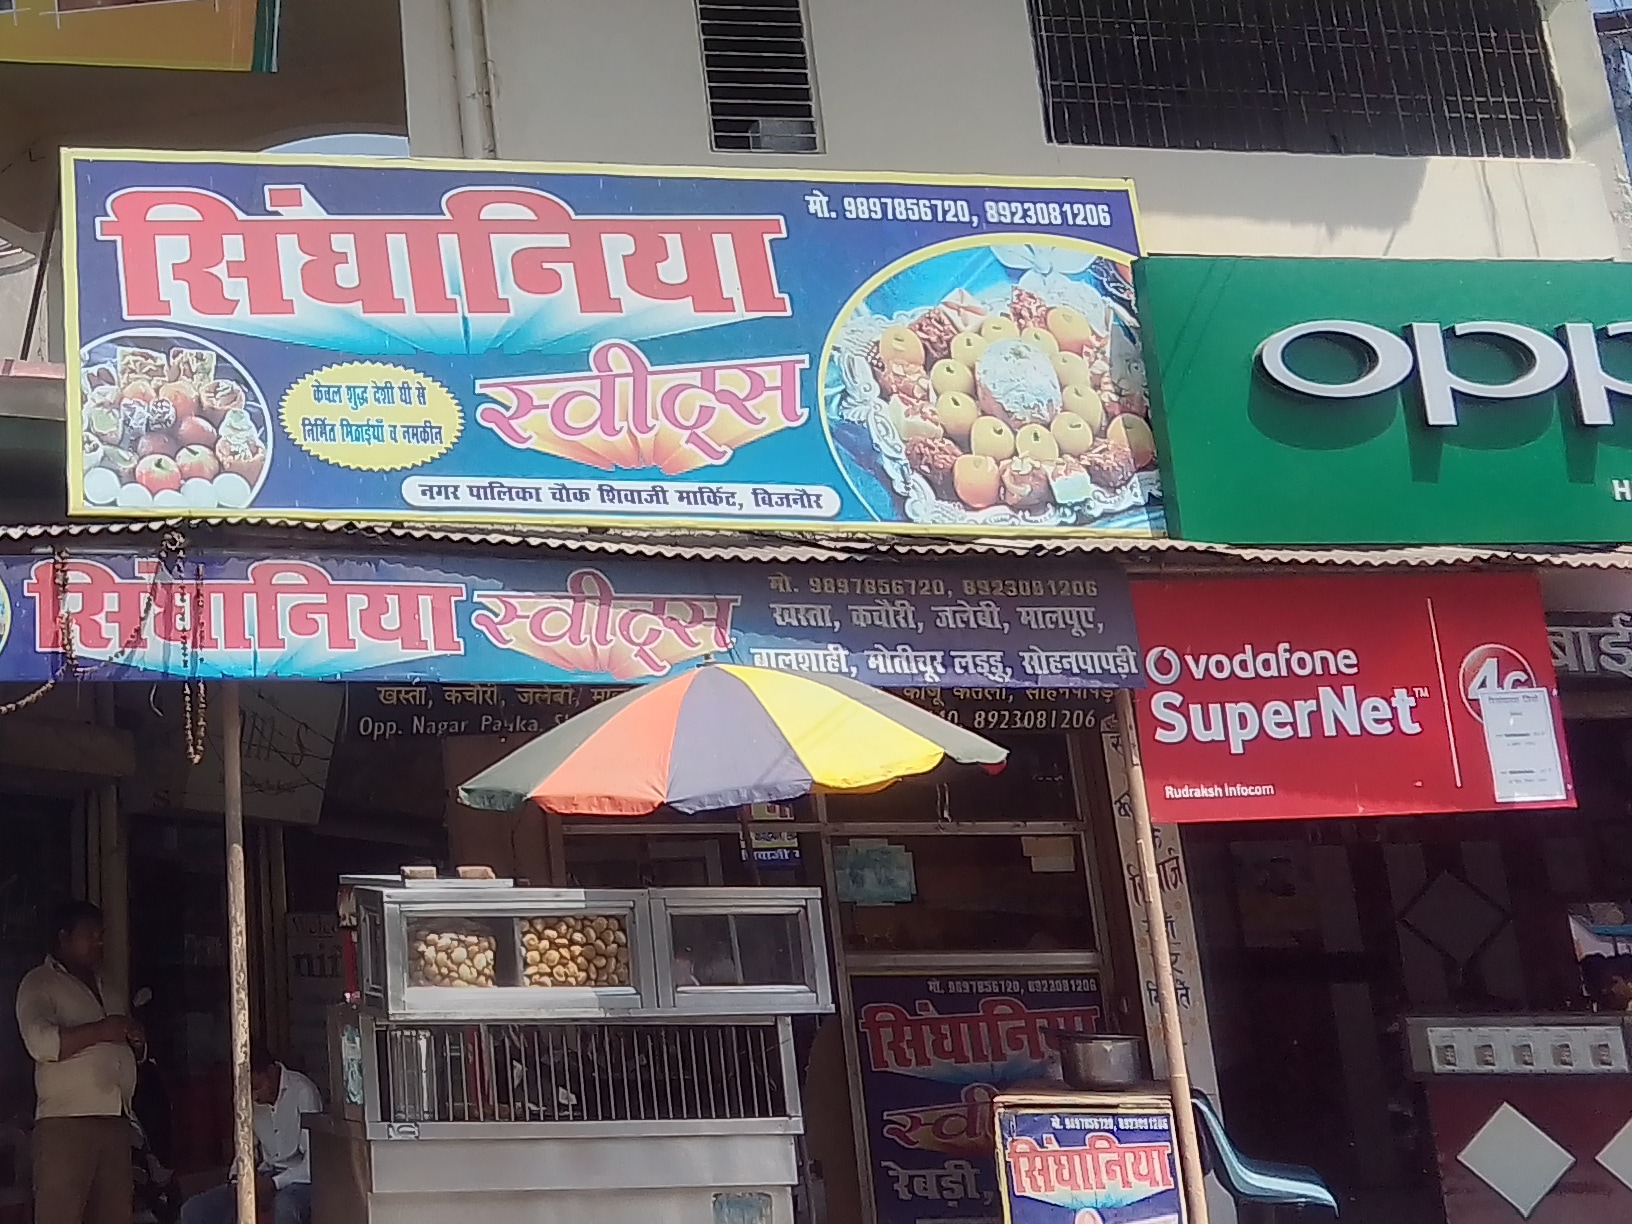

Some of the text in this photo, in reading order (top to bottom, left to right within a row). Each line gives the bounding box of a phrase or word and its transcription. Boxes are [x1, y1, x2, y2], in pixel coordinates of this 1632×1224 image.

[804, 189, 1112, 228] मो. 9897856720, 8923081206
[95, 184, 791, 319] सिंघानिया
[371, 380, 395, 405] देशी
[397, 380, 413, 406] घी
[415, 381, 427, 406] से
[476, 338, 811, 466] स्वीट्स
[400, 420, 444, 445] नमकीन
[418, 482, 460, 501] नगर
[467, 481, 542, 503] पालिका
[548, 482, 591, 503] चौक
[597, 483, 669, 505] शिवाजी
[752, 487, 824, 509] बिजनौर
[809, 577, 953, 599] 9897856720,
[961, 579, 1098, 597] 8923081206
[24, 557, 743, 678] सिंघानिया स्वीट्स
[769, 602, 842, 633] खस्ता,
[847, 601, 925, 634] कचौरी,
[930, 601, 1010, 635] जलेबी,
[1184, 641, 1359, 681] vodafone
[358, 716, 403, 741] Opp.
[411, 715, 468, 737] Nagar
[973, 709, 1097, 730] 8923081206
[1150, 684, 1423, 755] SuperNet
[1164, 782, 1275, 799] Rudraksh Infocom
[1006, 1132, 1175, 1196] सिंघानिया
